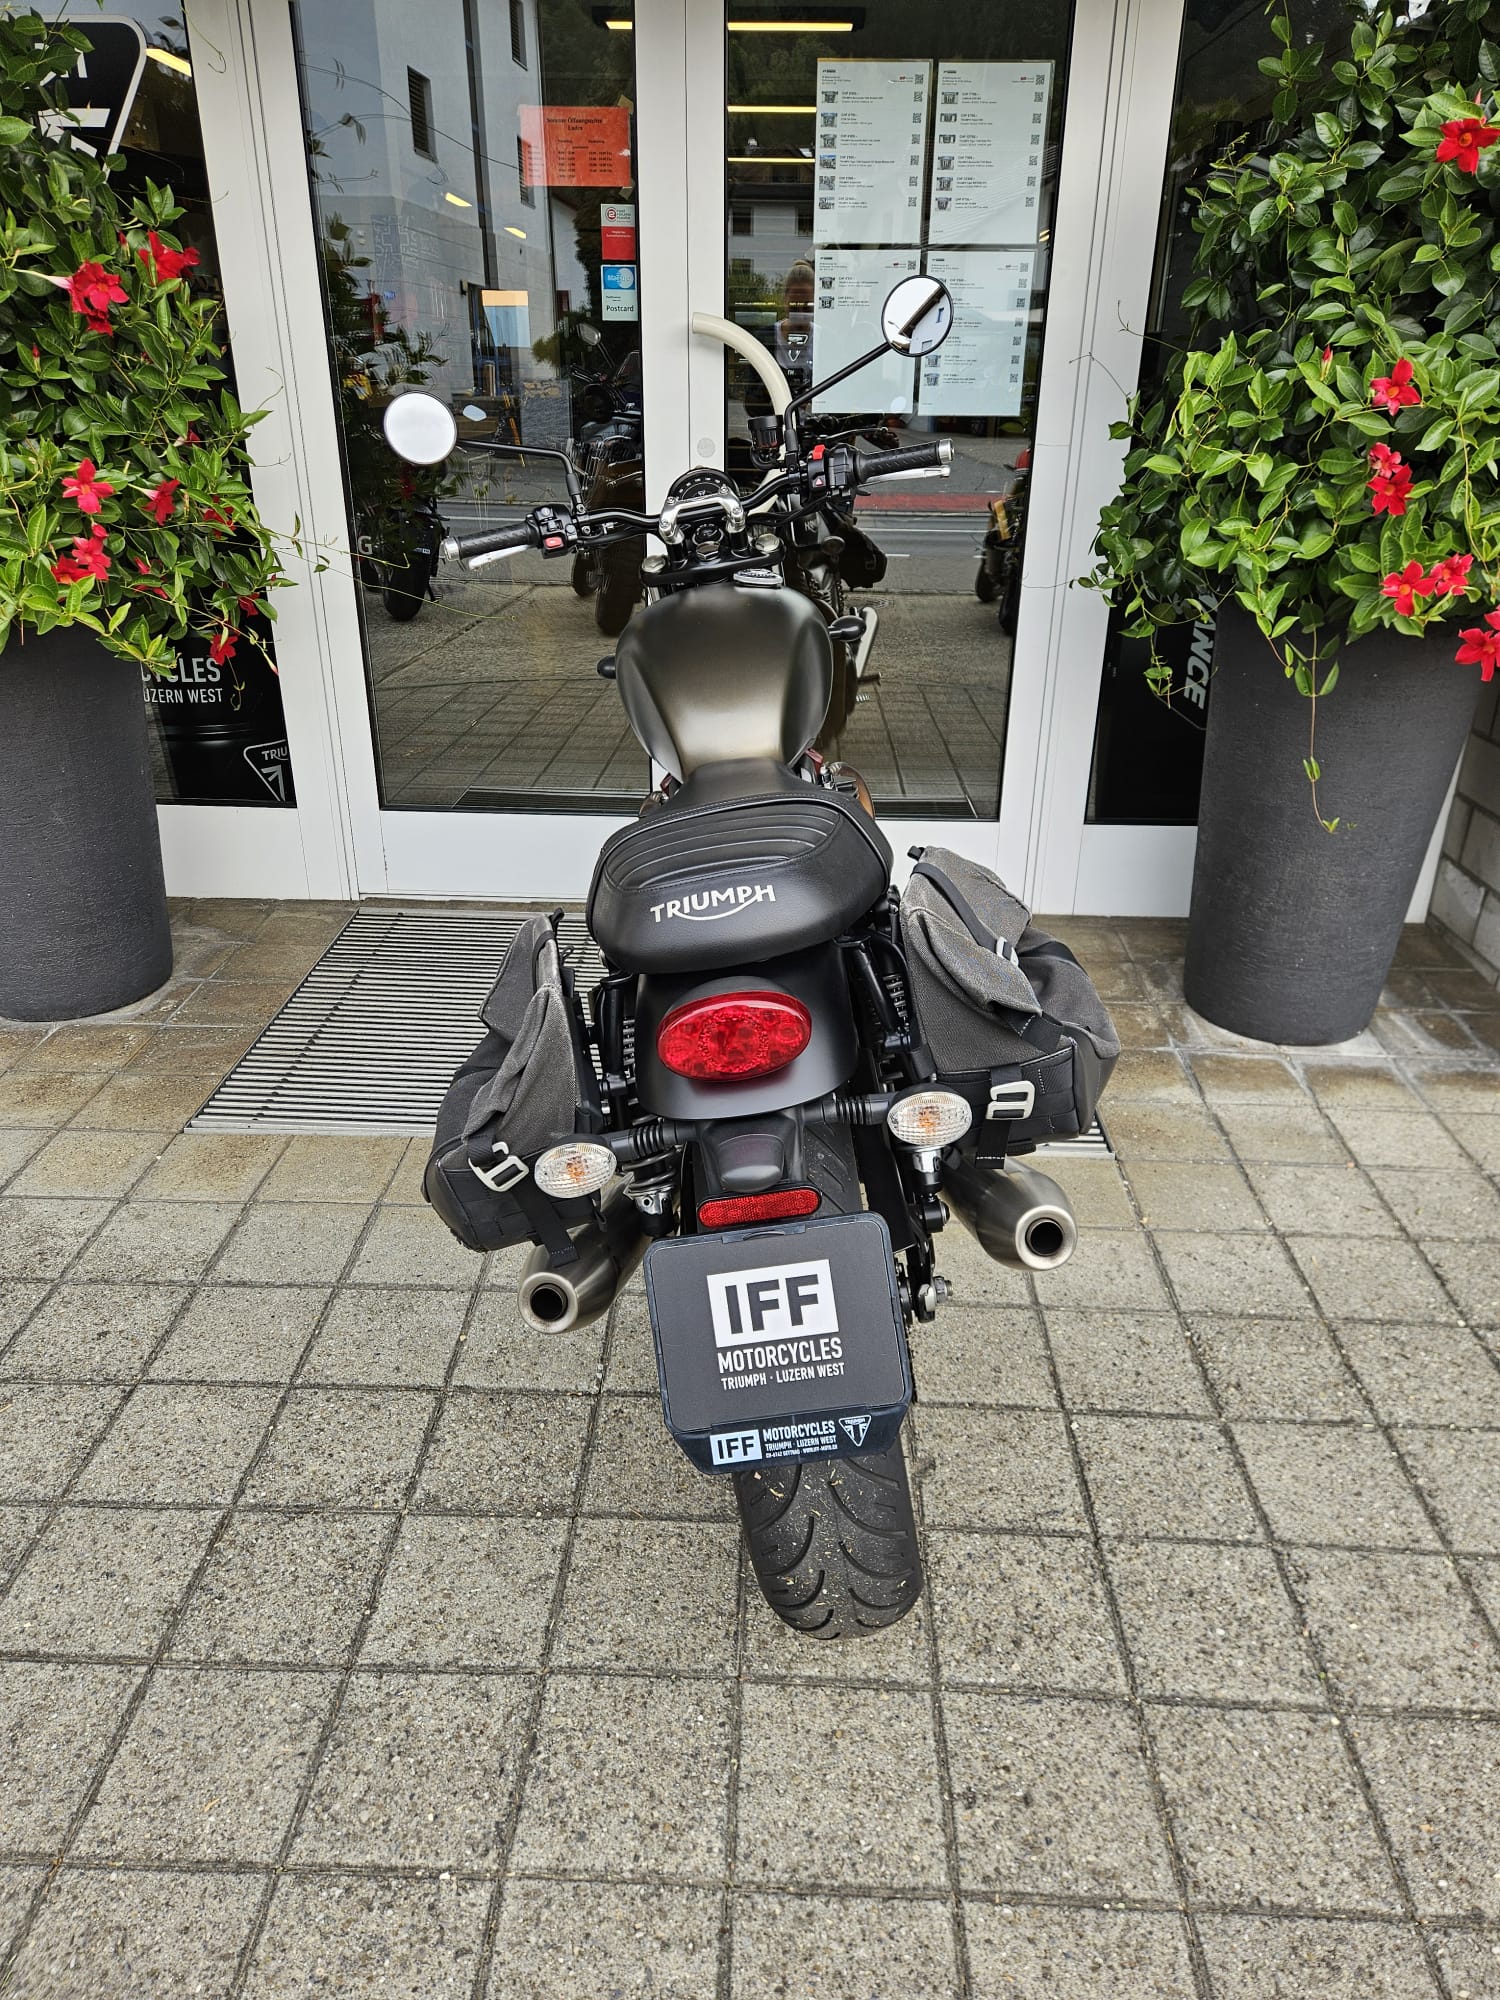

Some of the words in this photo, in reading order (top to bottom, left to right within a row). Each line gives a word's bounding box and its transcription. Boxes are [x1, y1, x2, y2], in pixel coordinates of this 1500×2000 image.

[606, 304, 634, 312] Postcard
[187, 688, 223, 703] WEST
[650, 884, 776, 922] TRIUMPH
[724, 1273, 820, 1335] IFF
[717, 1336, 843, 1374] MOTORCYCLES
[721, 1372, 767, 1390] TRIUMPH
[776, 1365, 815, 1384] LUZERN
[817, 1362, 845, 1378] WEST
[762, 1420, 836, 1442] MOTORCYCLES
[765, 1441, 792, 1451] TRIUMPH
[796, 1437, 820, 1448] LUZERN
[820, 1434, 837, 1445] WEST
[717, 1435, 755, 1460] IFF
